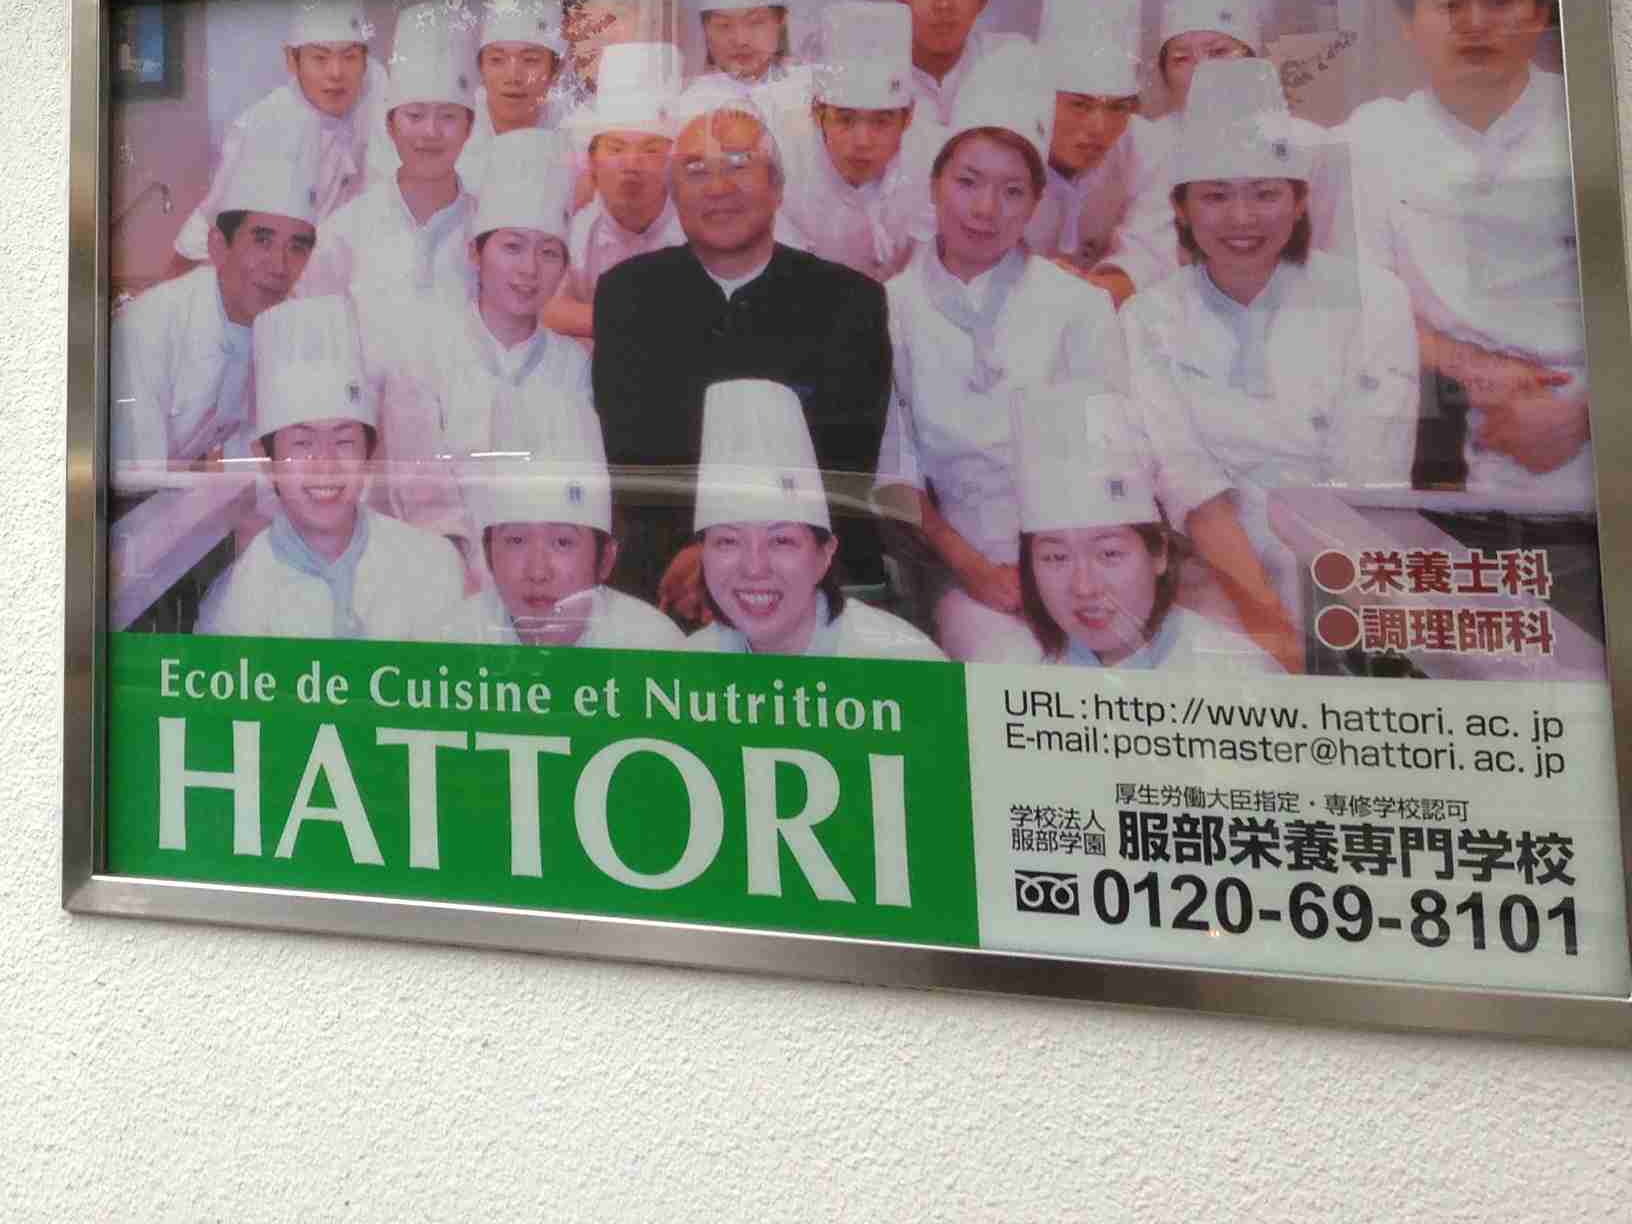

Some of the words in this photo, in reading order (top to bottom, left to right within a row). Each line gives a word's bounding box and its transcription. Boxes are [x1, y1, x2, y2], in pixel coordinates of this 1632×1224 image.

[160, 658, 276, 701] Ecole
[297, 661, 349, 705] de
[369, 665, 551, 714] Cuisine
[574, 678, 621, 718] et
[645, 677, 901, 731] Nutrition
[159, 716, 912, 907] HATTORI
[1010, 804, 1106, 832] 学校法人
[1011, 828, 1107, 856] 服部学園
[1118, 810, 1576, 886] 服部栄養専門学校
[1092, 868, 1578, 957] 0120-69-8101
